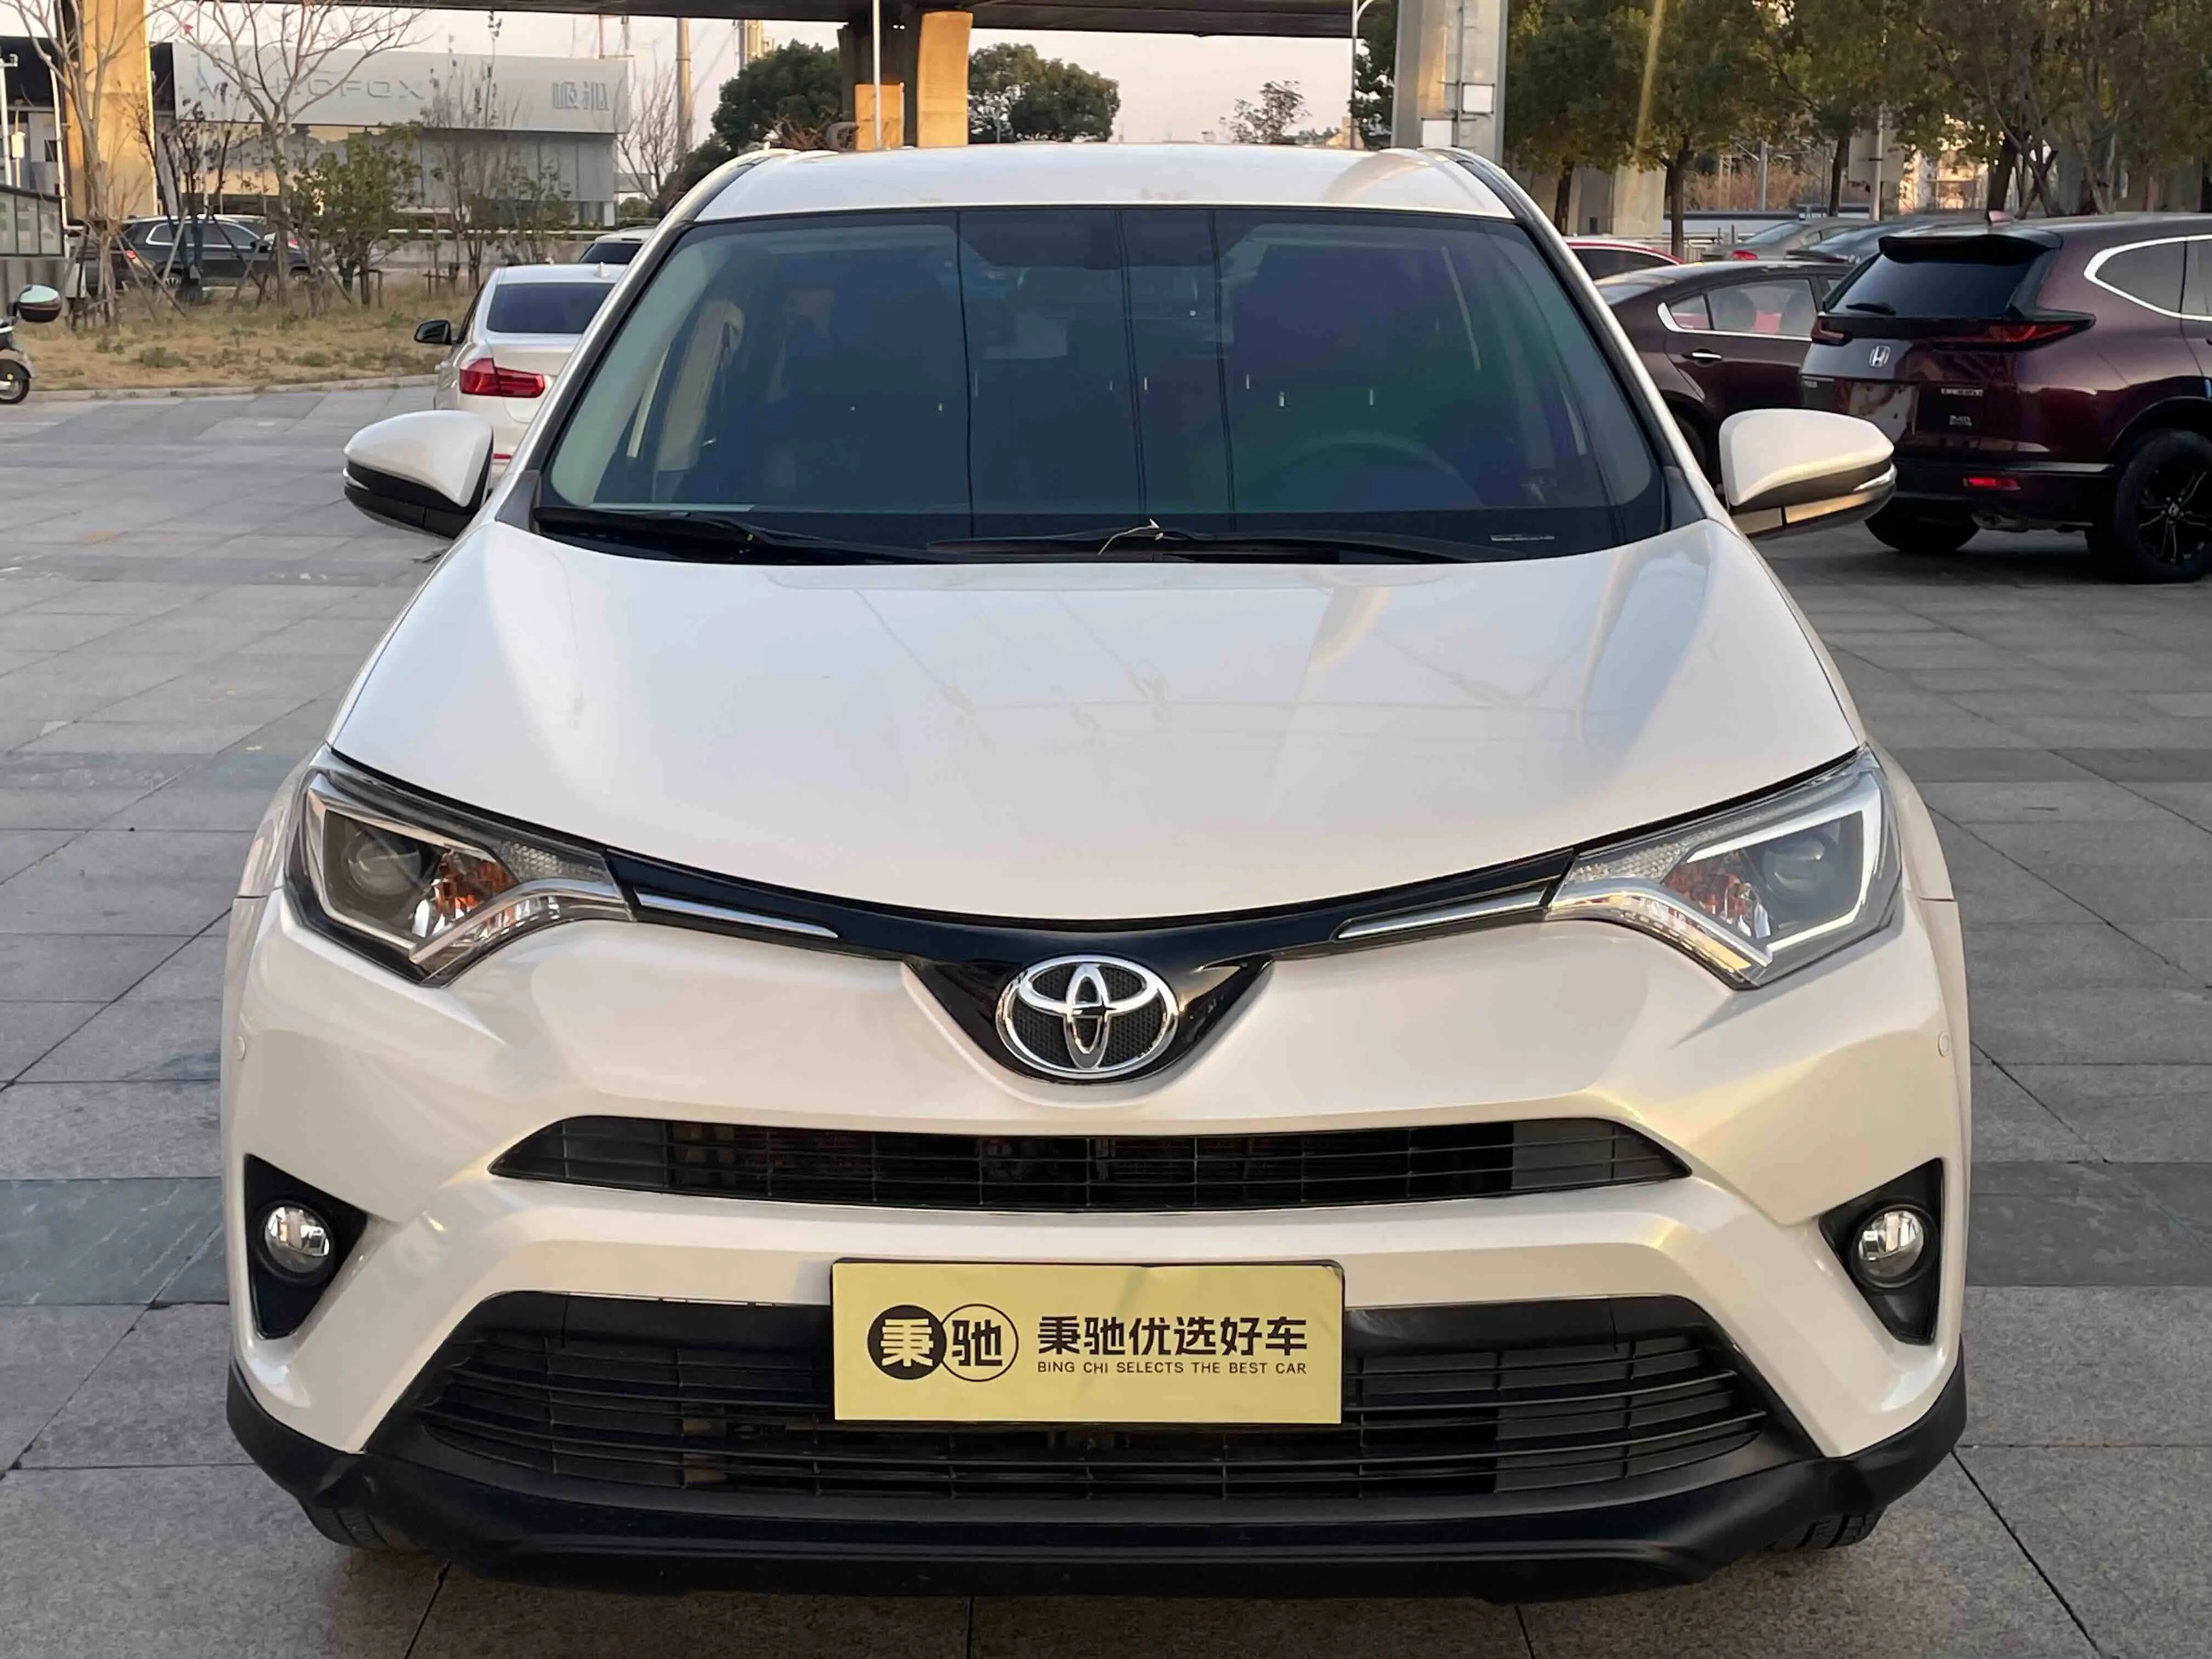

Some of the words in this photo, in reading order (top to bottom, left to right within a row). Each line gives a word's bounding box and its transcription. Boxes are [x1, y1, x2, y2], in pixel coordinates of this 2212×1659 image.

[881, 1318, 1003, 1367] 秉驰
[1037, 1316, 1307, 1356] 秉驰优选好车
[1037, 1361, 1075, 1373] BING
[1083, 1362, 1108, 1373] CHI
[1116, 1362, 1184, 1374] SELECTS
[1192, 1362, 1220, 1374] THE
[1229, 1362, 1267, 1374] BEST
[1276, 1362, 1307, 1374] CAR
